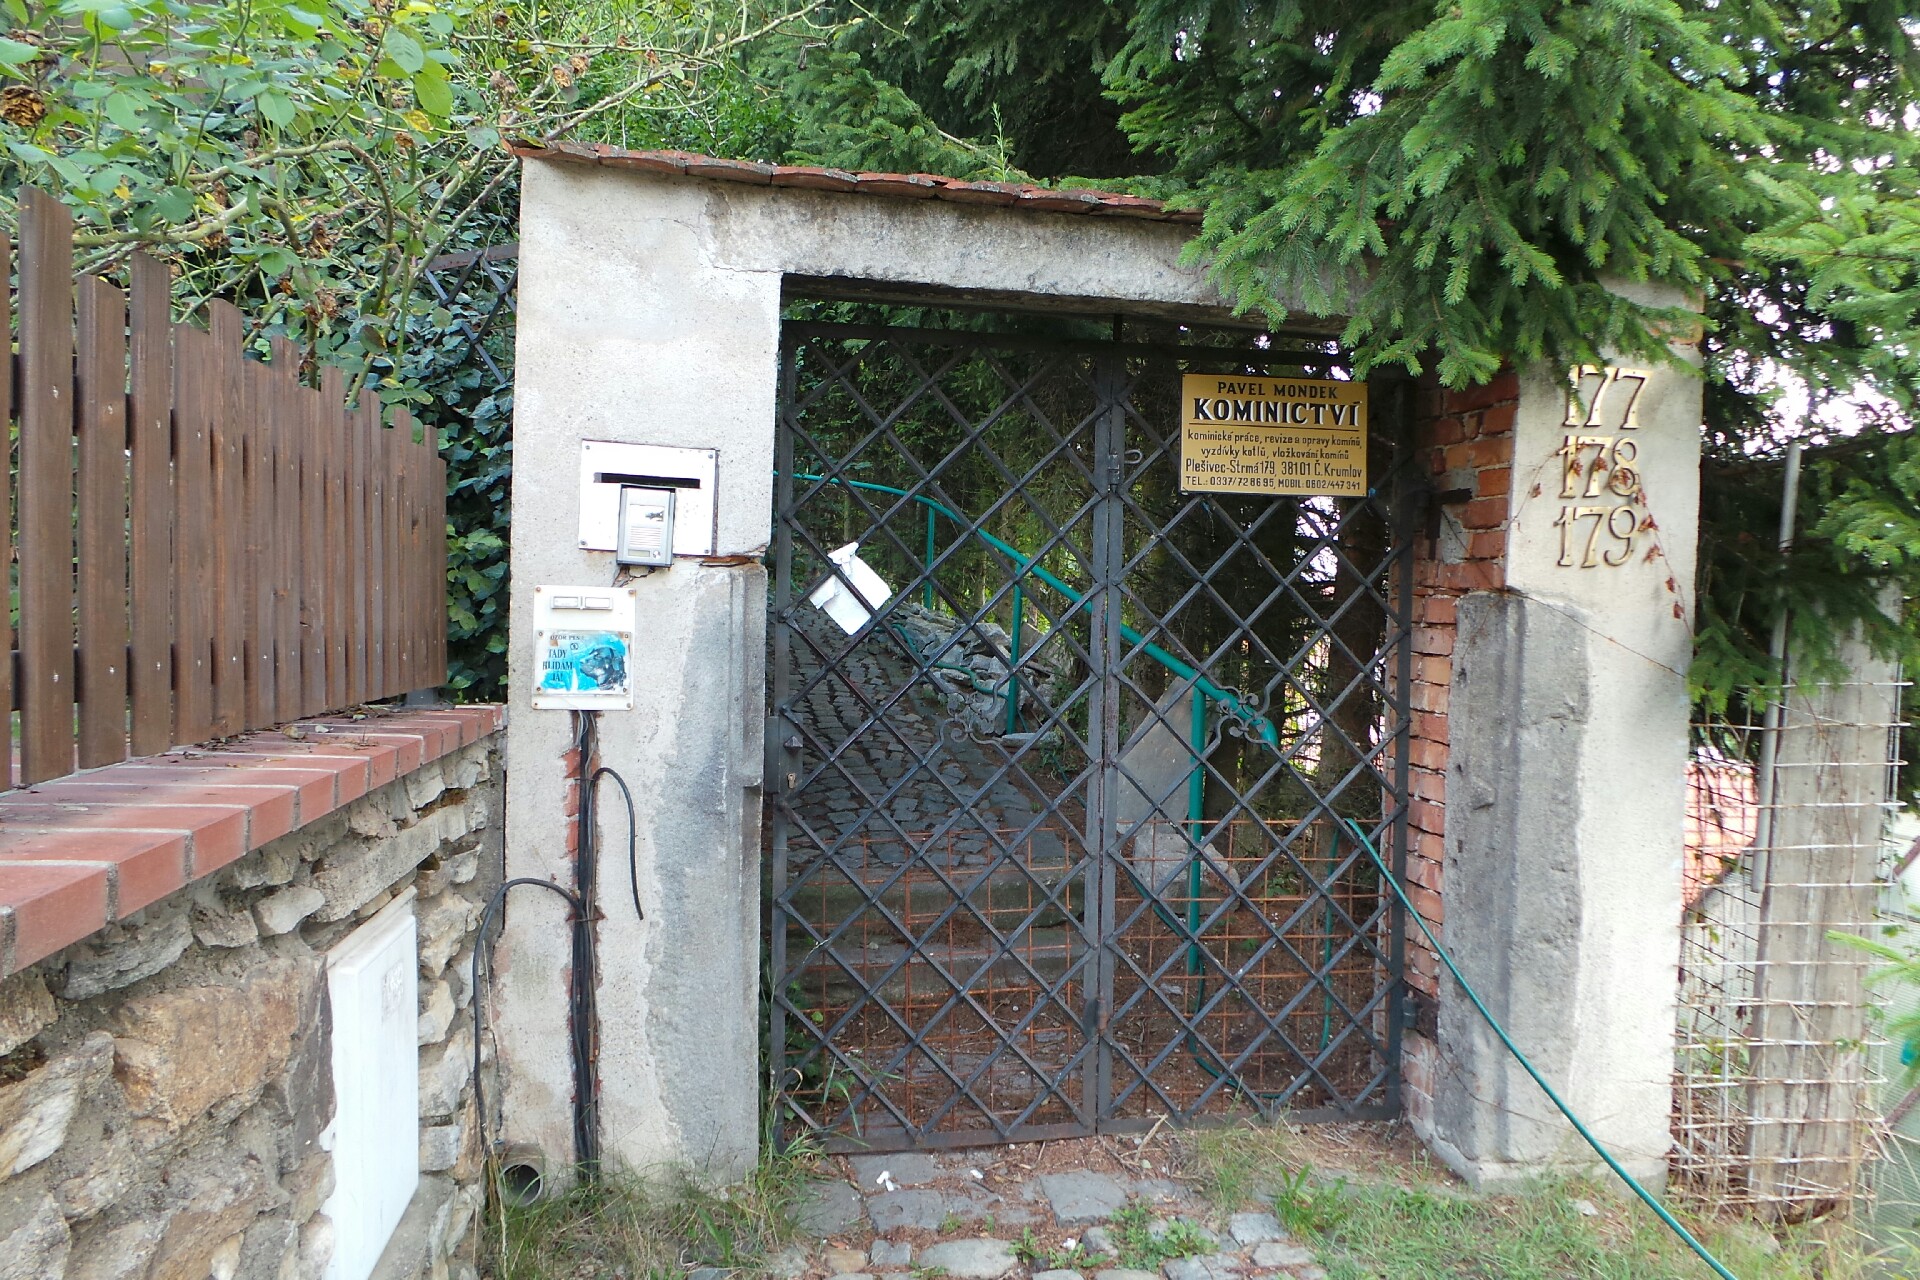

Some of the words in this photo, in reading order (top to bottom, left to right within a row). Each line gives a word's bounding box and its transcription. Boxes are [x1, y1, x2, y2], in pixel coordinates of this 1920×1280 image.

[1217, 381, 1266, 395] PAVEL
[1273, 384, 1338, 399] MONDEK
[1562, 364, 1653, 429] 177
[1193, 397, 1362, 427] KOMINICTVÍ
[1188, 429, 1233, 441] kominické
[1234, 432, 1262, 444] práce,
[1265, 433, 1293, 443] revize
[1302, 437, 1330, 448] opravy
[1331, 435, 1362, 449] komínů,
[1201, 445, 1240, 459] vyzdívky
[1242, 445, 1269, 459] kotlů,
[1272, 447, 1318, 459] vložkování
[1320, 448, 1349, 459] komínů
[1186, 458, 1259, 473] Plešivec-Strmá
[1260, 460, 1277, 477] 179,
[1557, 435, 1640, 498] 178
[1278, 478, 1304, 488] MOBIL:
[1553, 505, 1637, 568] 179
[548, 648, 567, 658] TADY
